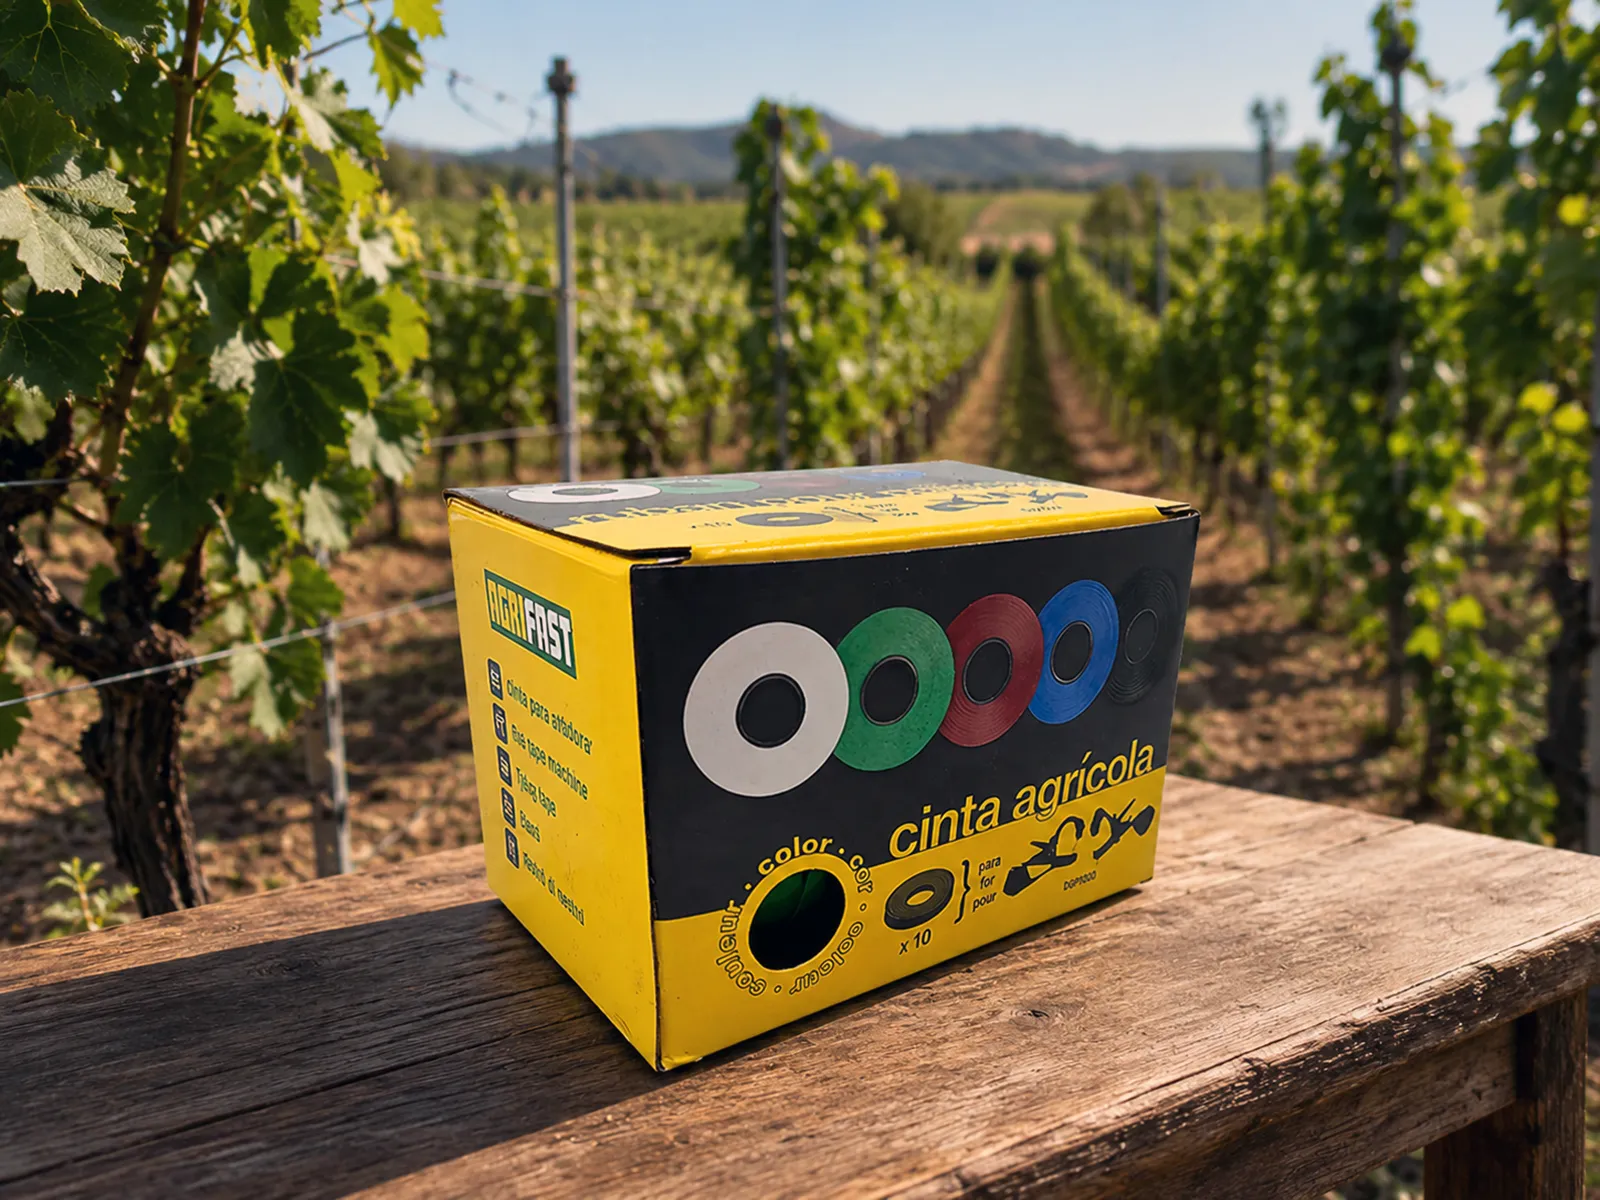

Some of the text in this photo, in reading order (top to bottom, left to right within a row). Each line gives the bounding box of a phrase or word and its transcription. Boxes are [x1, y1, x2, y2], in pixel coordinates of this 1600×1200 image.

[487, 578, 572, 668] AGRIFAST
[548, 755, 588, 800] machine
[889, 739, 1154, 858] cinta agrícola
[758, 836, 833, 876] color
[849, 854, 873, 893] cor
[978, 856, 1001, 876] para
[972, 892, 997, 912] pour
[980, 875, 996, 890] for
[899, 928, 931, 955] x 10
